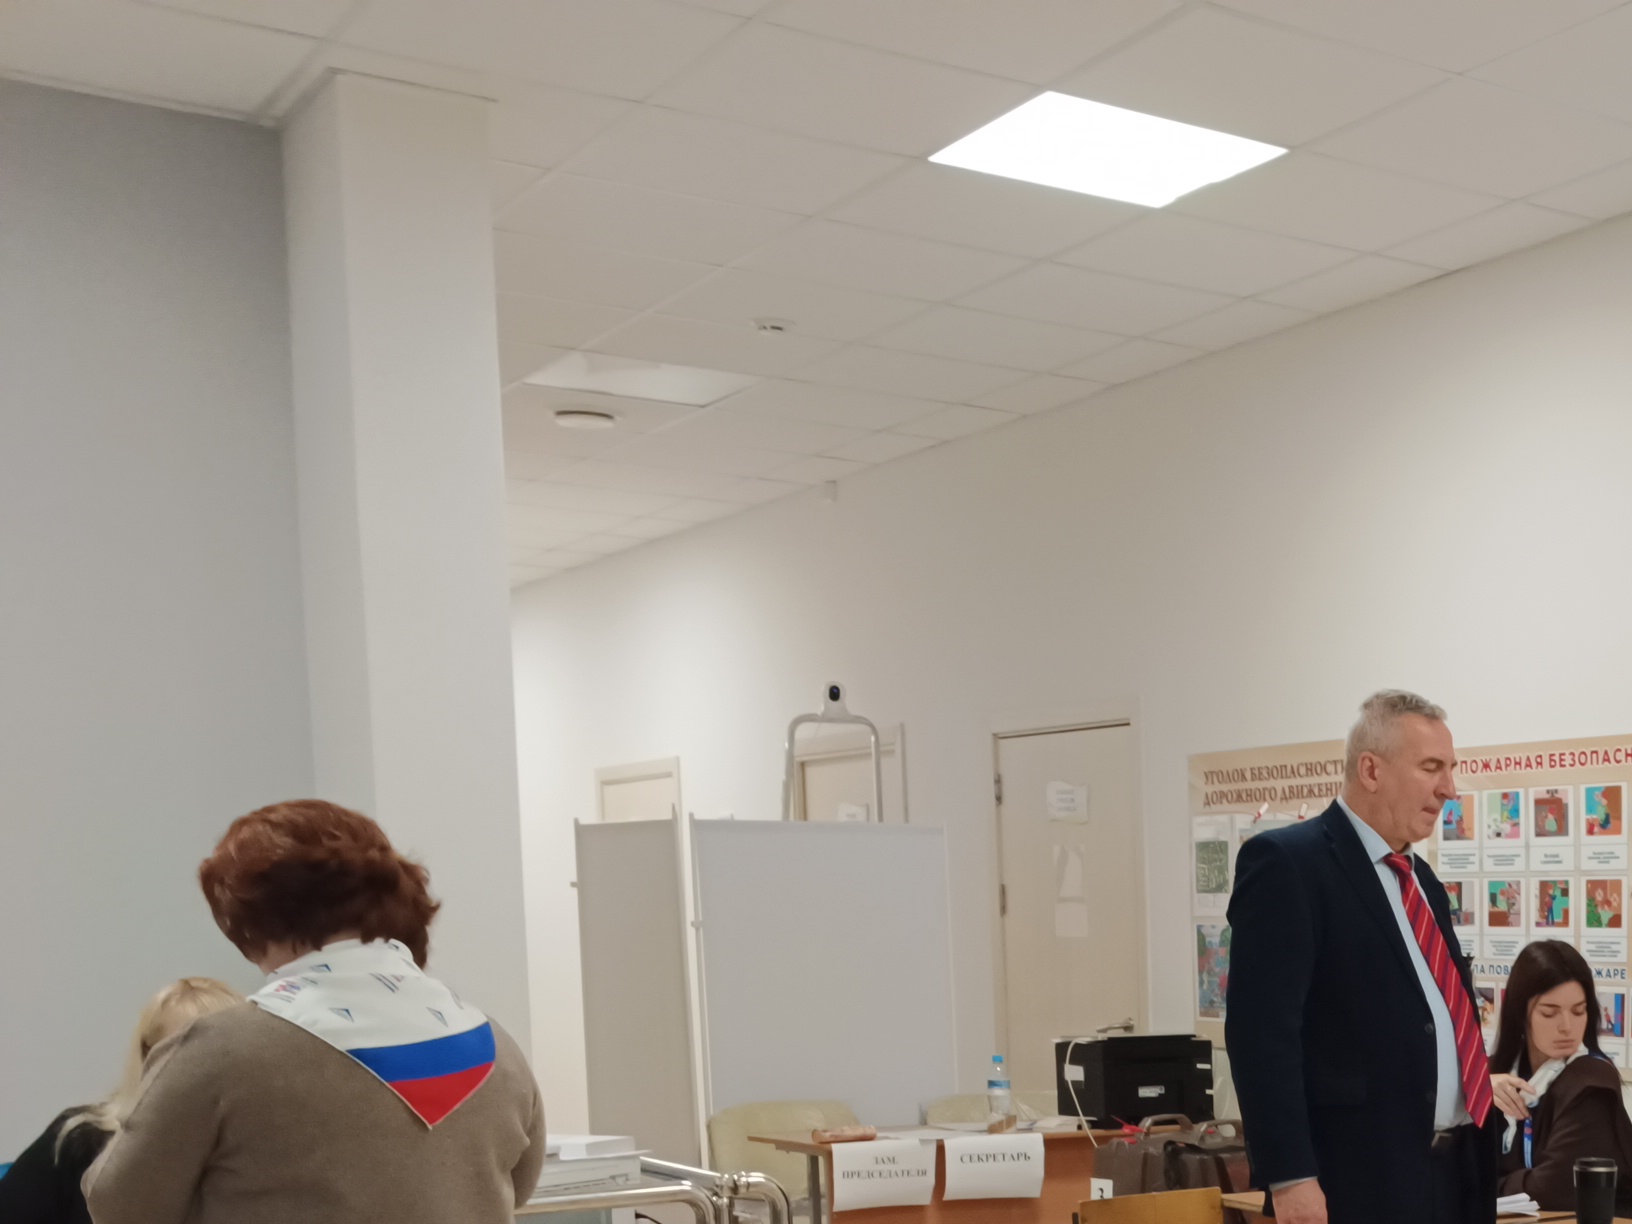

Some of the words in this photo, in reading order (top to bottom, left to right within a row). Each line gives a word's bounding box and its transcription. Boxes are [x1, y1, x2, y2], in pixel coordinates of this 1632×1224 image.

[1460, 754, 1544, 775] ПОЖАРНАЯ
[1203, 768, 1248, 785] УГОЛОК
[1203, 786, 1278, 808] ДОРОЖНОГО
[1593, 967, 1627, 980] ЖАРЕ
[959, 1152, 1032, 1165] СЕКРЕТАРЬ
[841, 1168, 928, 1181] ПРЕДСЕДАТЕЛЯ
